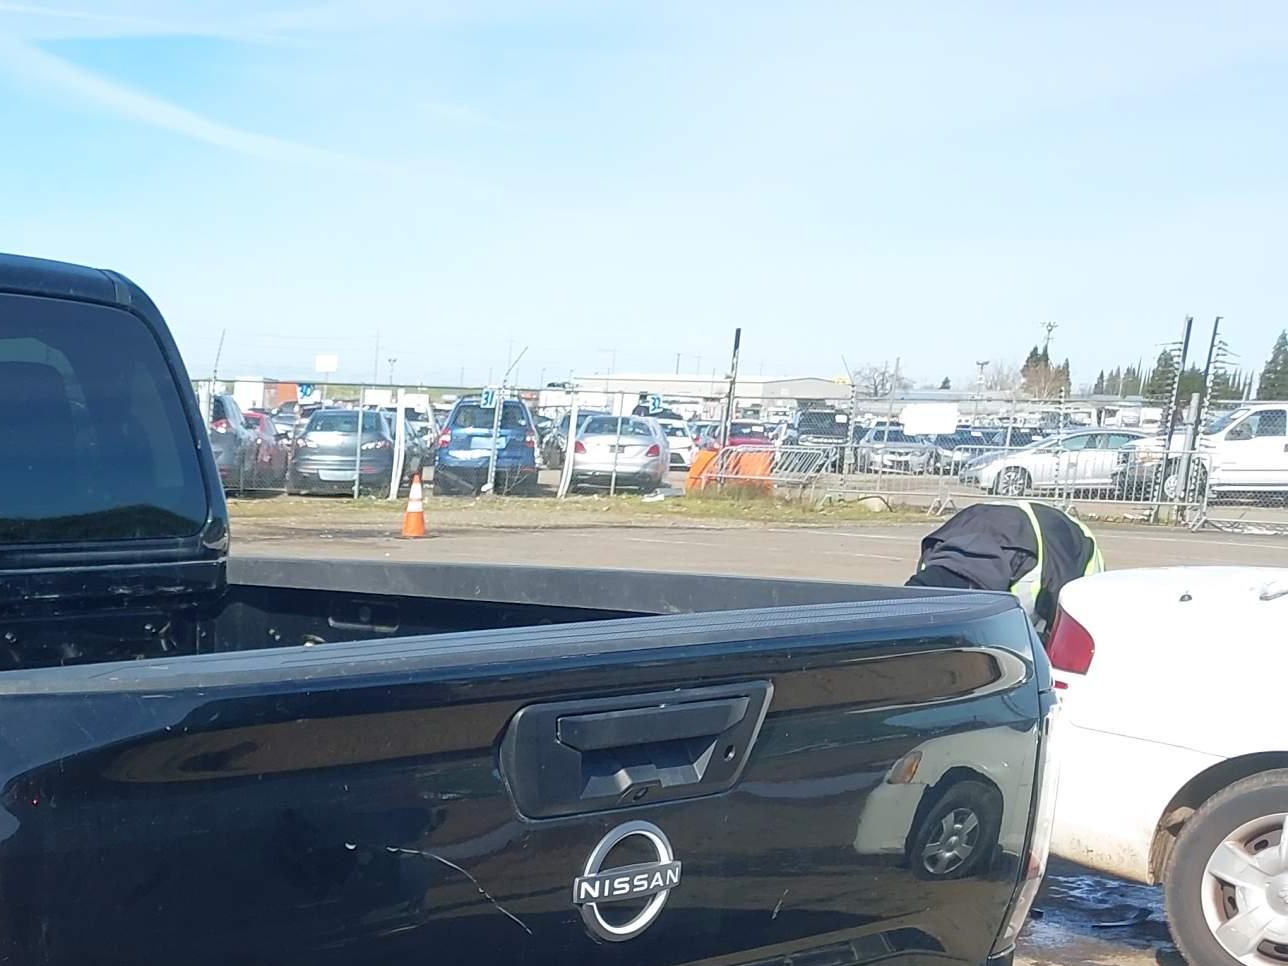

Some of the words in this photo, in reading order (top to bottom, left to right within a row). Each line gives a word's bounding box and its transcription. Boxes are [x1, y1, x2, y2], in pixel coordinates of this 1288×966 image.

[482, 390, 496, 407] 31
[650, 396, 663, 412] 32
[578, 866, 682, 900] NISSAN
